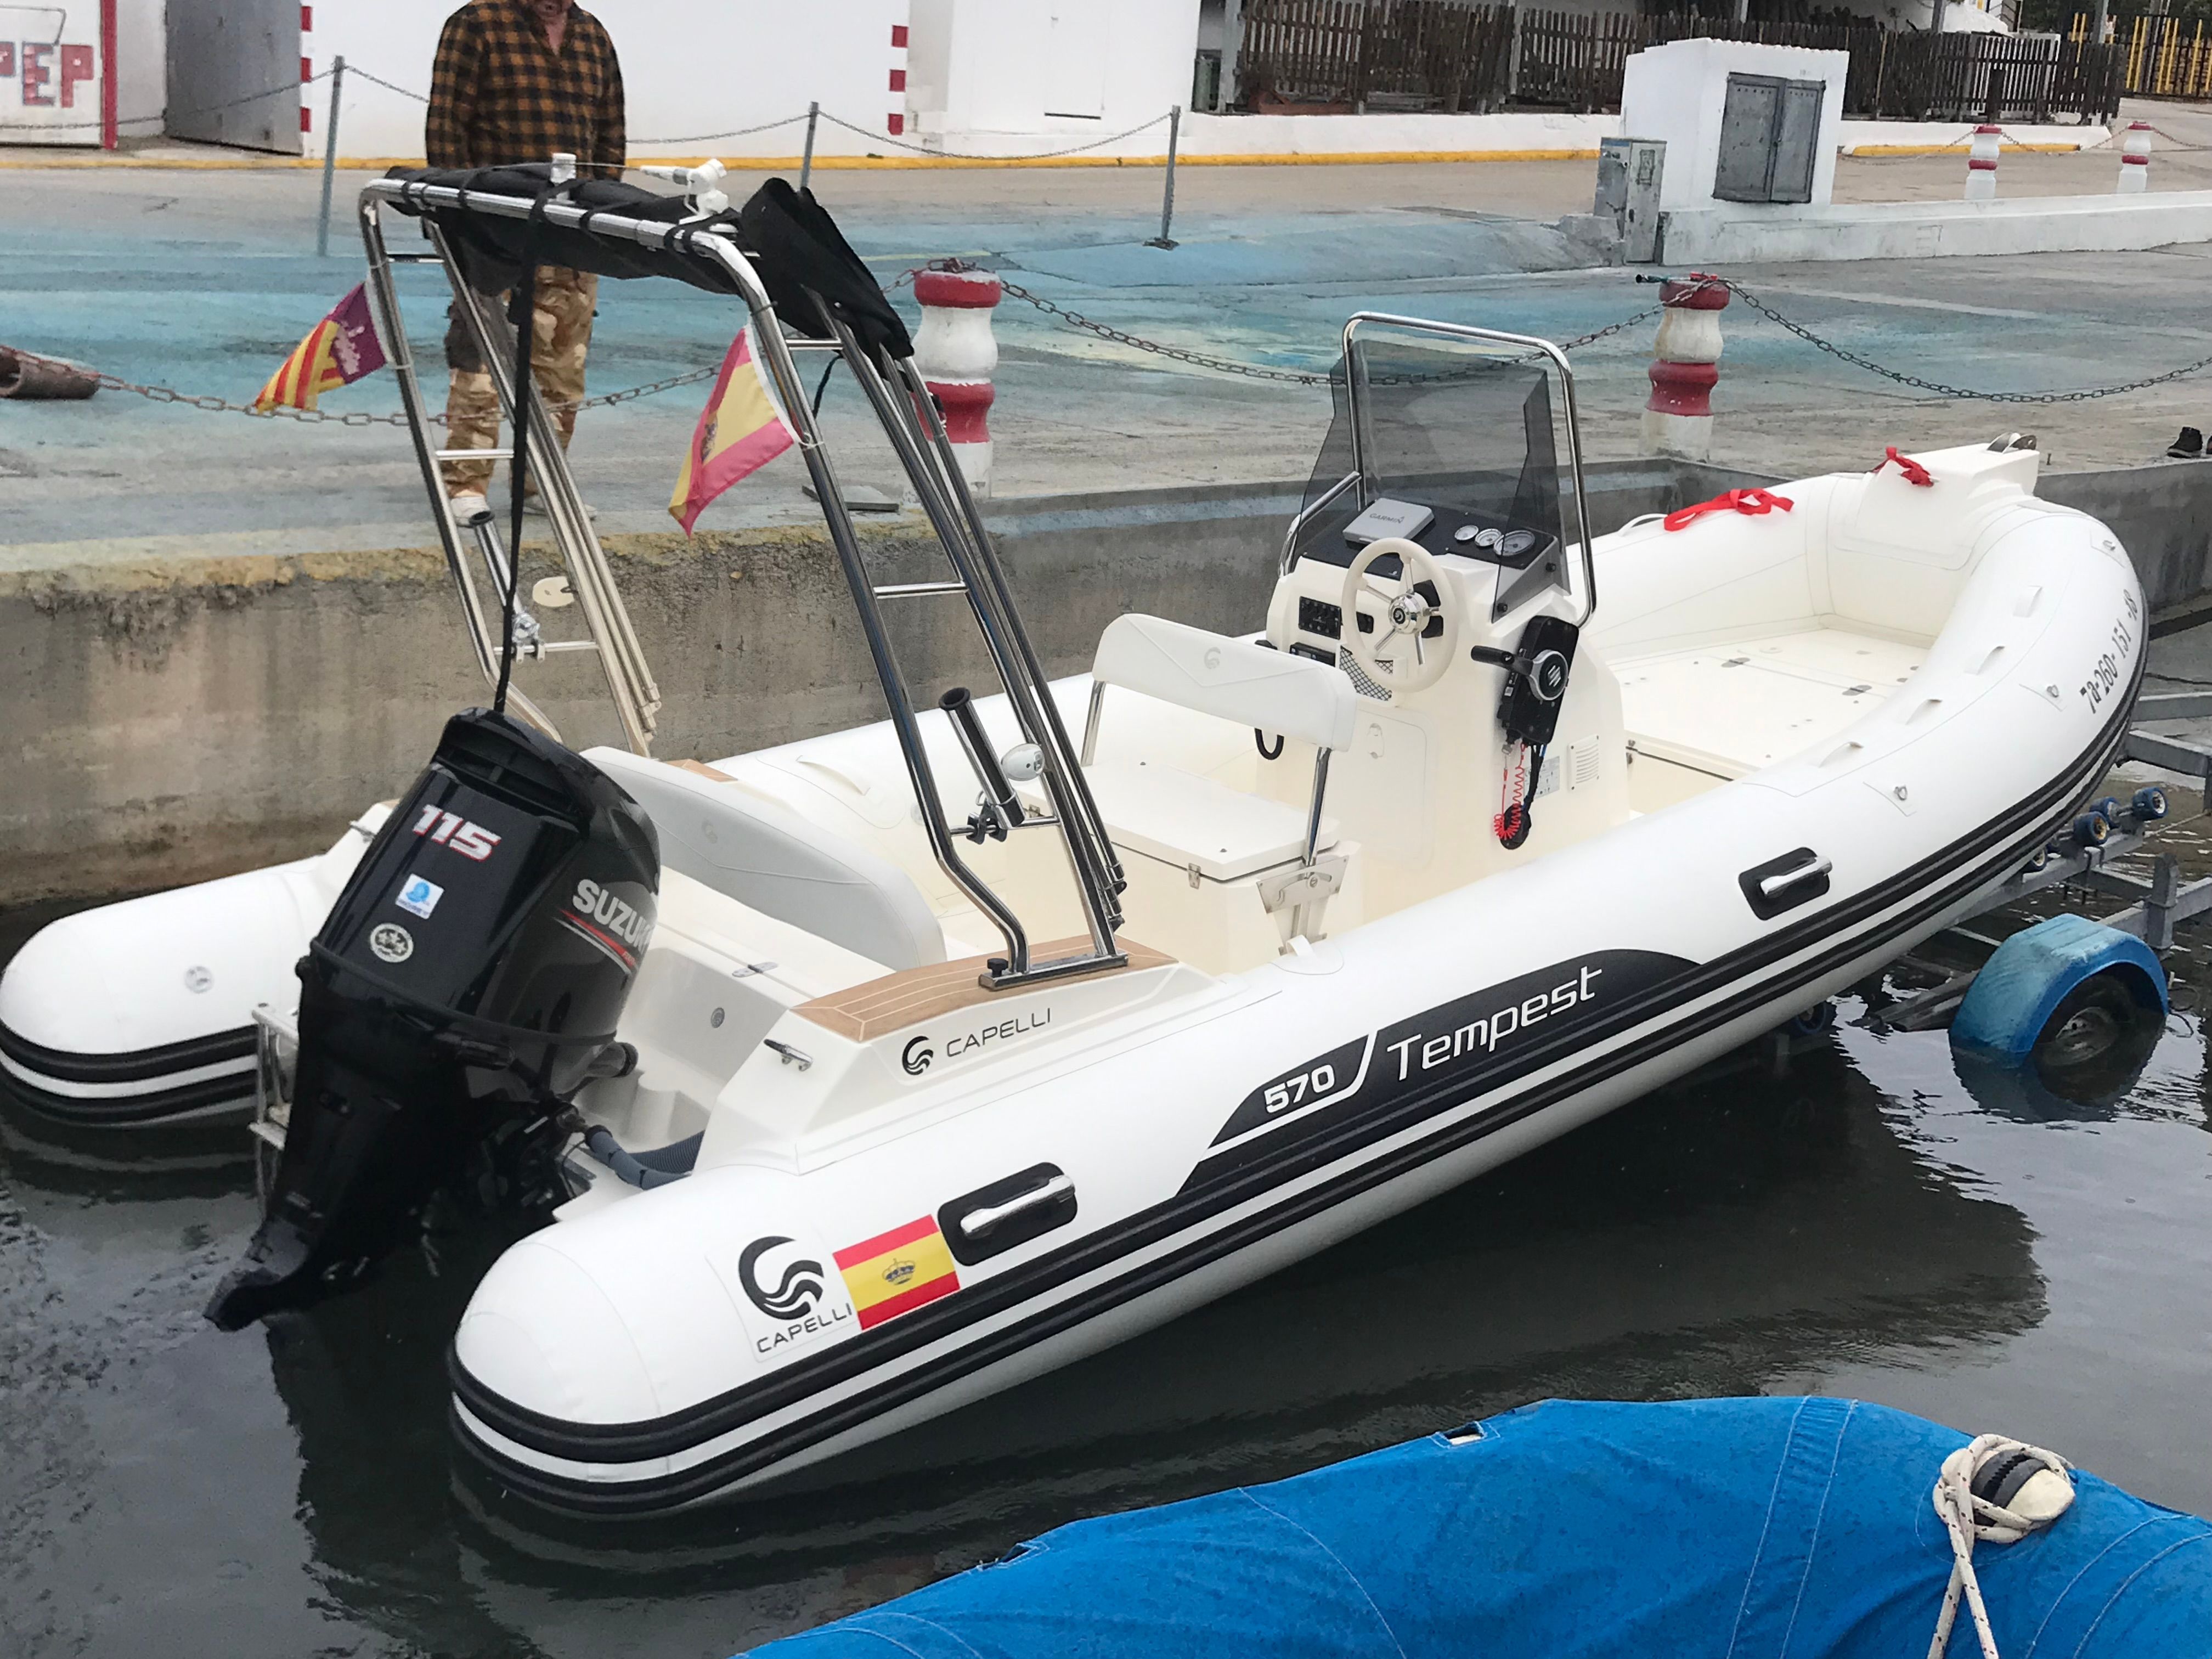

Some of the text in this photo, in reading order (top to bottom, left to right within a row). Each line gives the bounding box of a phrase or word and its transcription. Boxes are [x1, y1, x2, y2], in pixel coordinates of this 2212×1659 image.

[1369, 513, 1405, 523] GARMIN
[413, 804, 501, 861] 115
[946, 1007, 1051, 1057] CAPELLI
[1263, 966, 1602, 1114] 570 Tempest
[757, 1302, 853, 1353] CAPELLI
